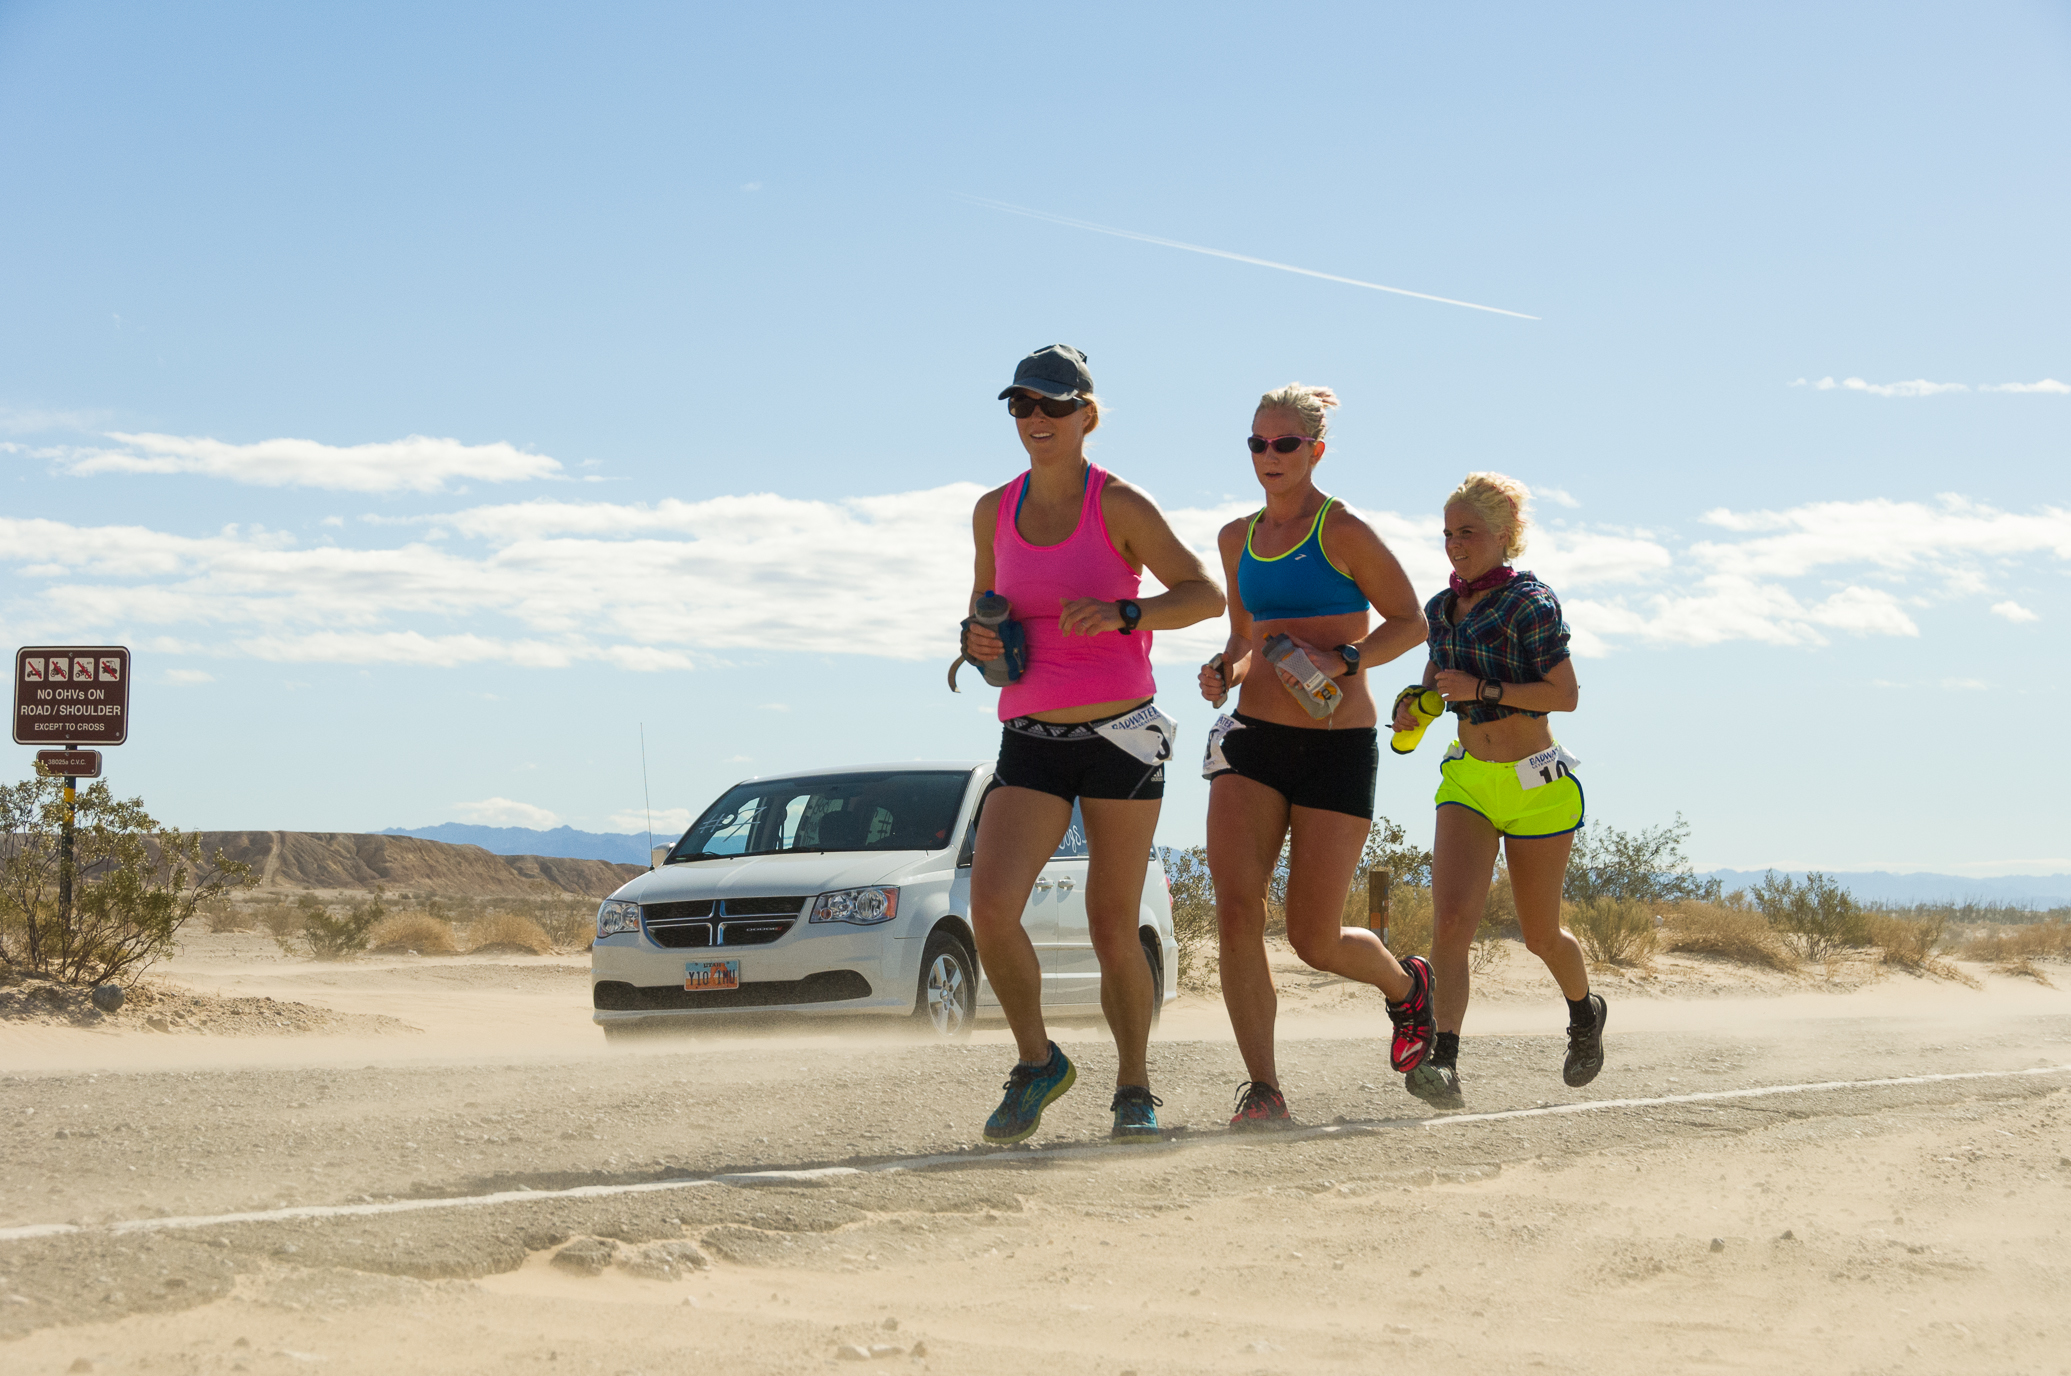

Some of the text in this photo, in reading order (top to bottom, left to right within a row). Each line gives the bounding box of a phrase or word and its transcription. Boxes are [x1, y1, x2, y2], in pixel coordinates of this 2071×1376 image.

[37, 689, 105, 700] NO OHVs ON
[20, 705, 51, 716] ROAD
[59, 705, 121, 716] SHOULDER
[34, 723, 105, 731] EXCEPT TO CROSS
